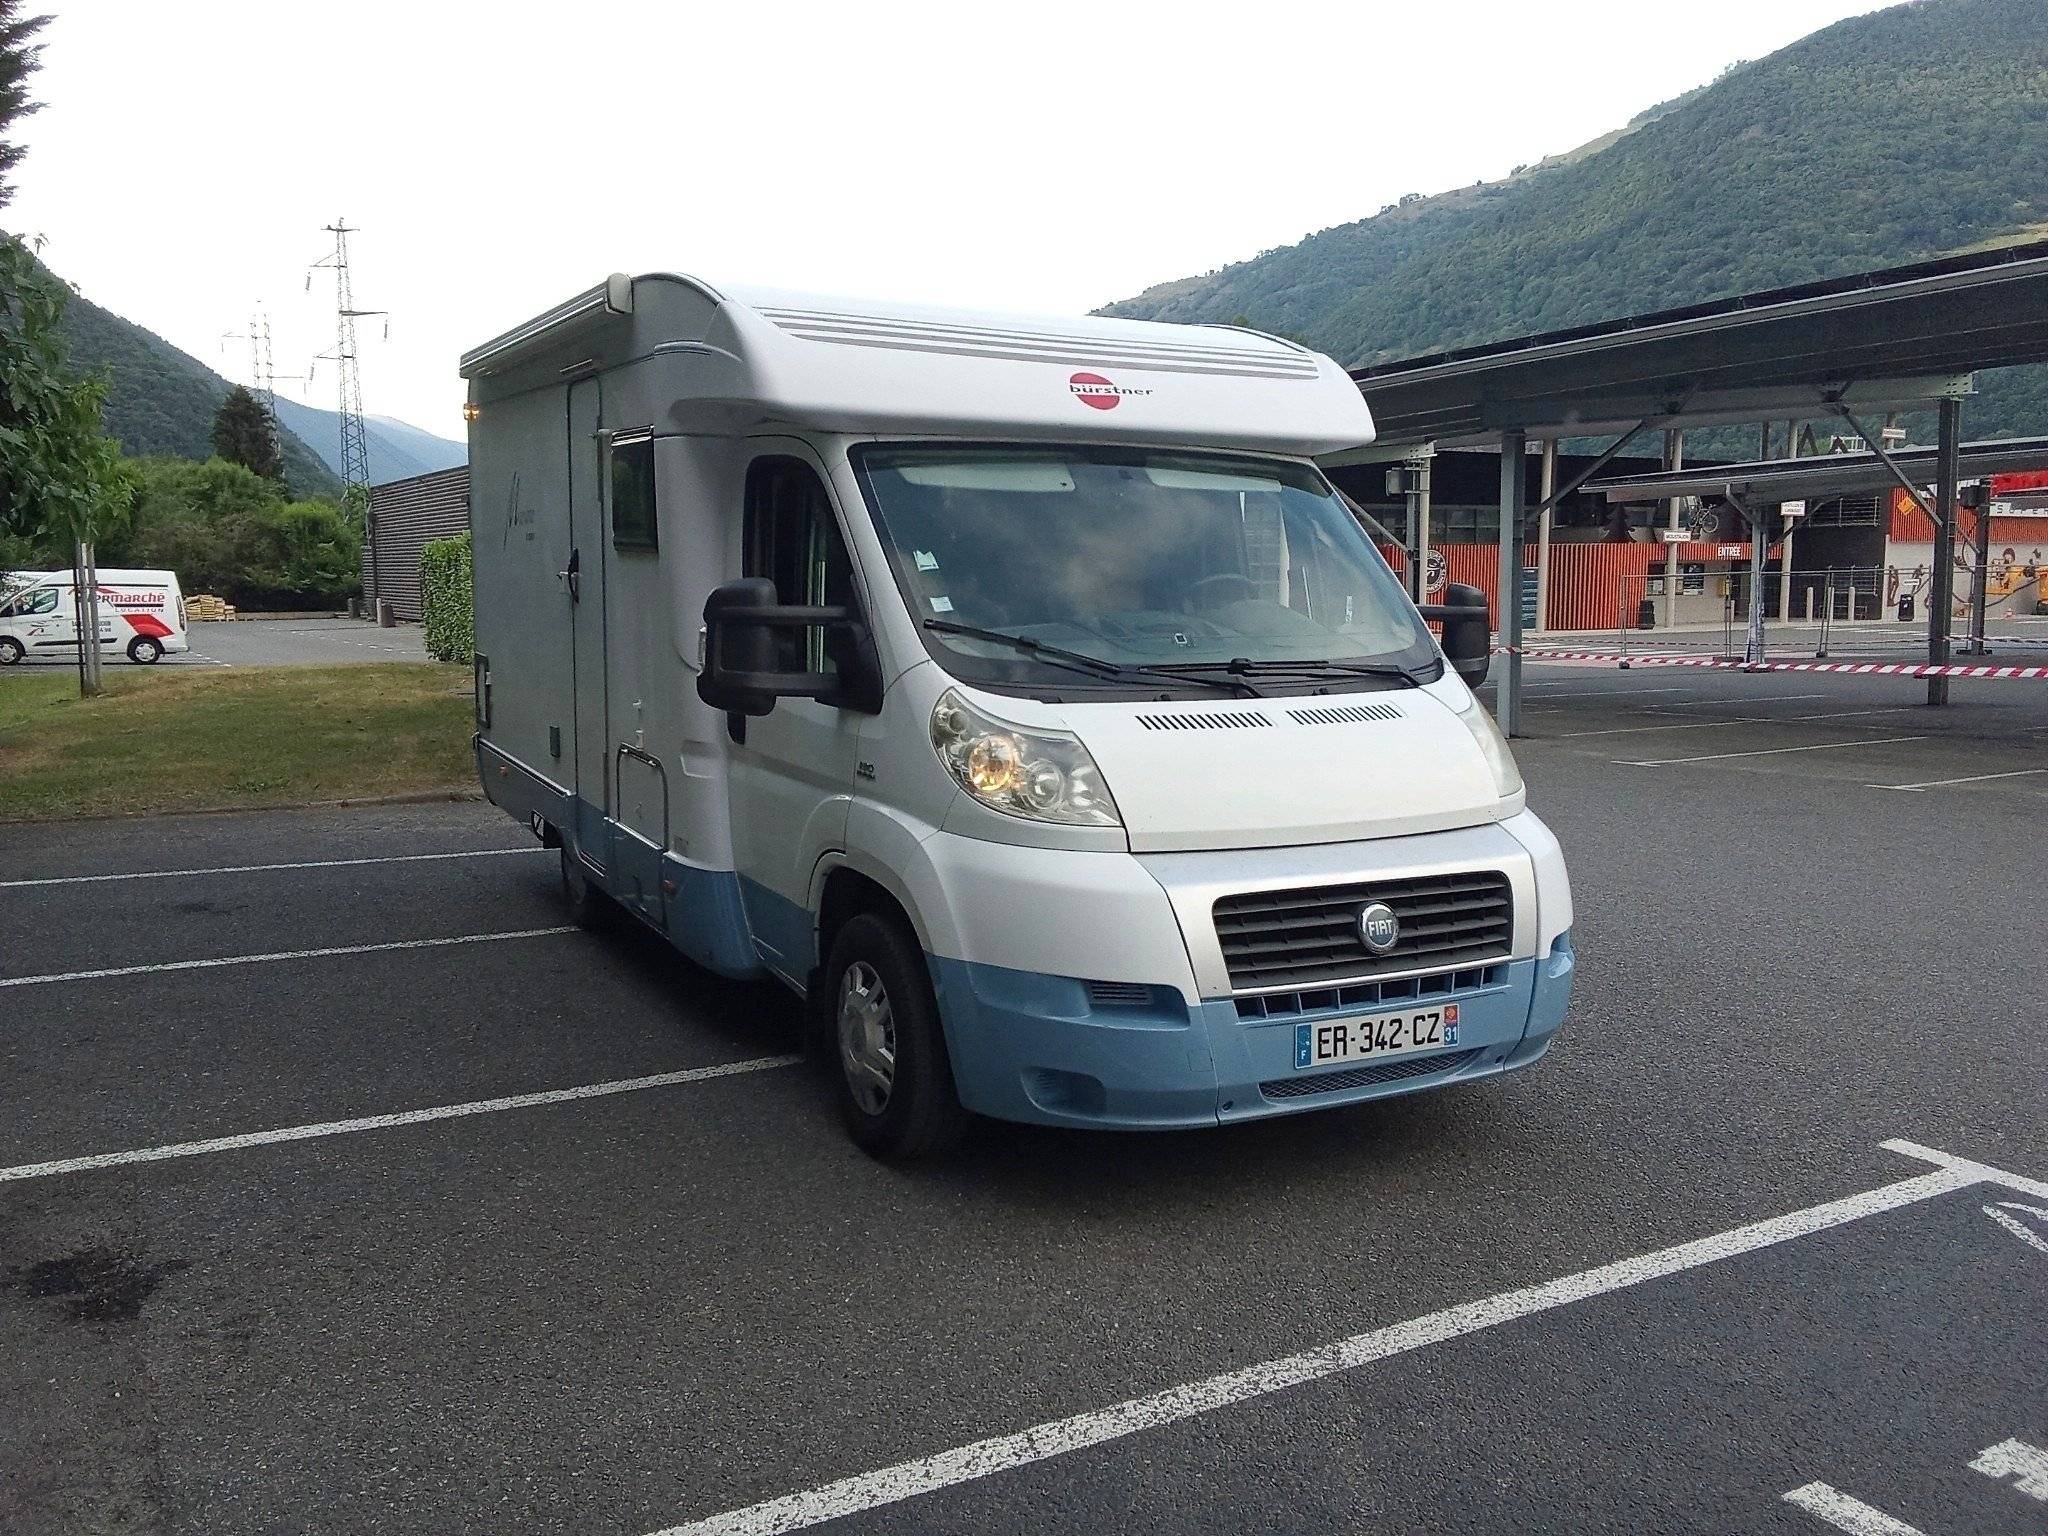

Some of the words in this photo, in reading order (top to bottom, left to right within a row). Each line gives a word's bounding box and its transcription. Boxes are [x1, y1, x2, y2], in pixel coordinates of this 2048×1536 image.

[1069, 384, 1154, 395] bürstner
[1368, 919, 1393, 937] FIAT
[1301, 1050, 1307, 1060] F
[1317, 1012, 1440, 1060] ER-342-CZ
[1445, 1026, 1457, 1042] 31
